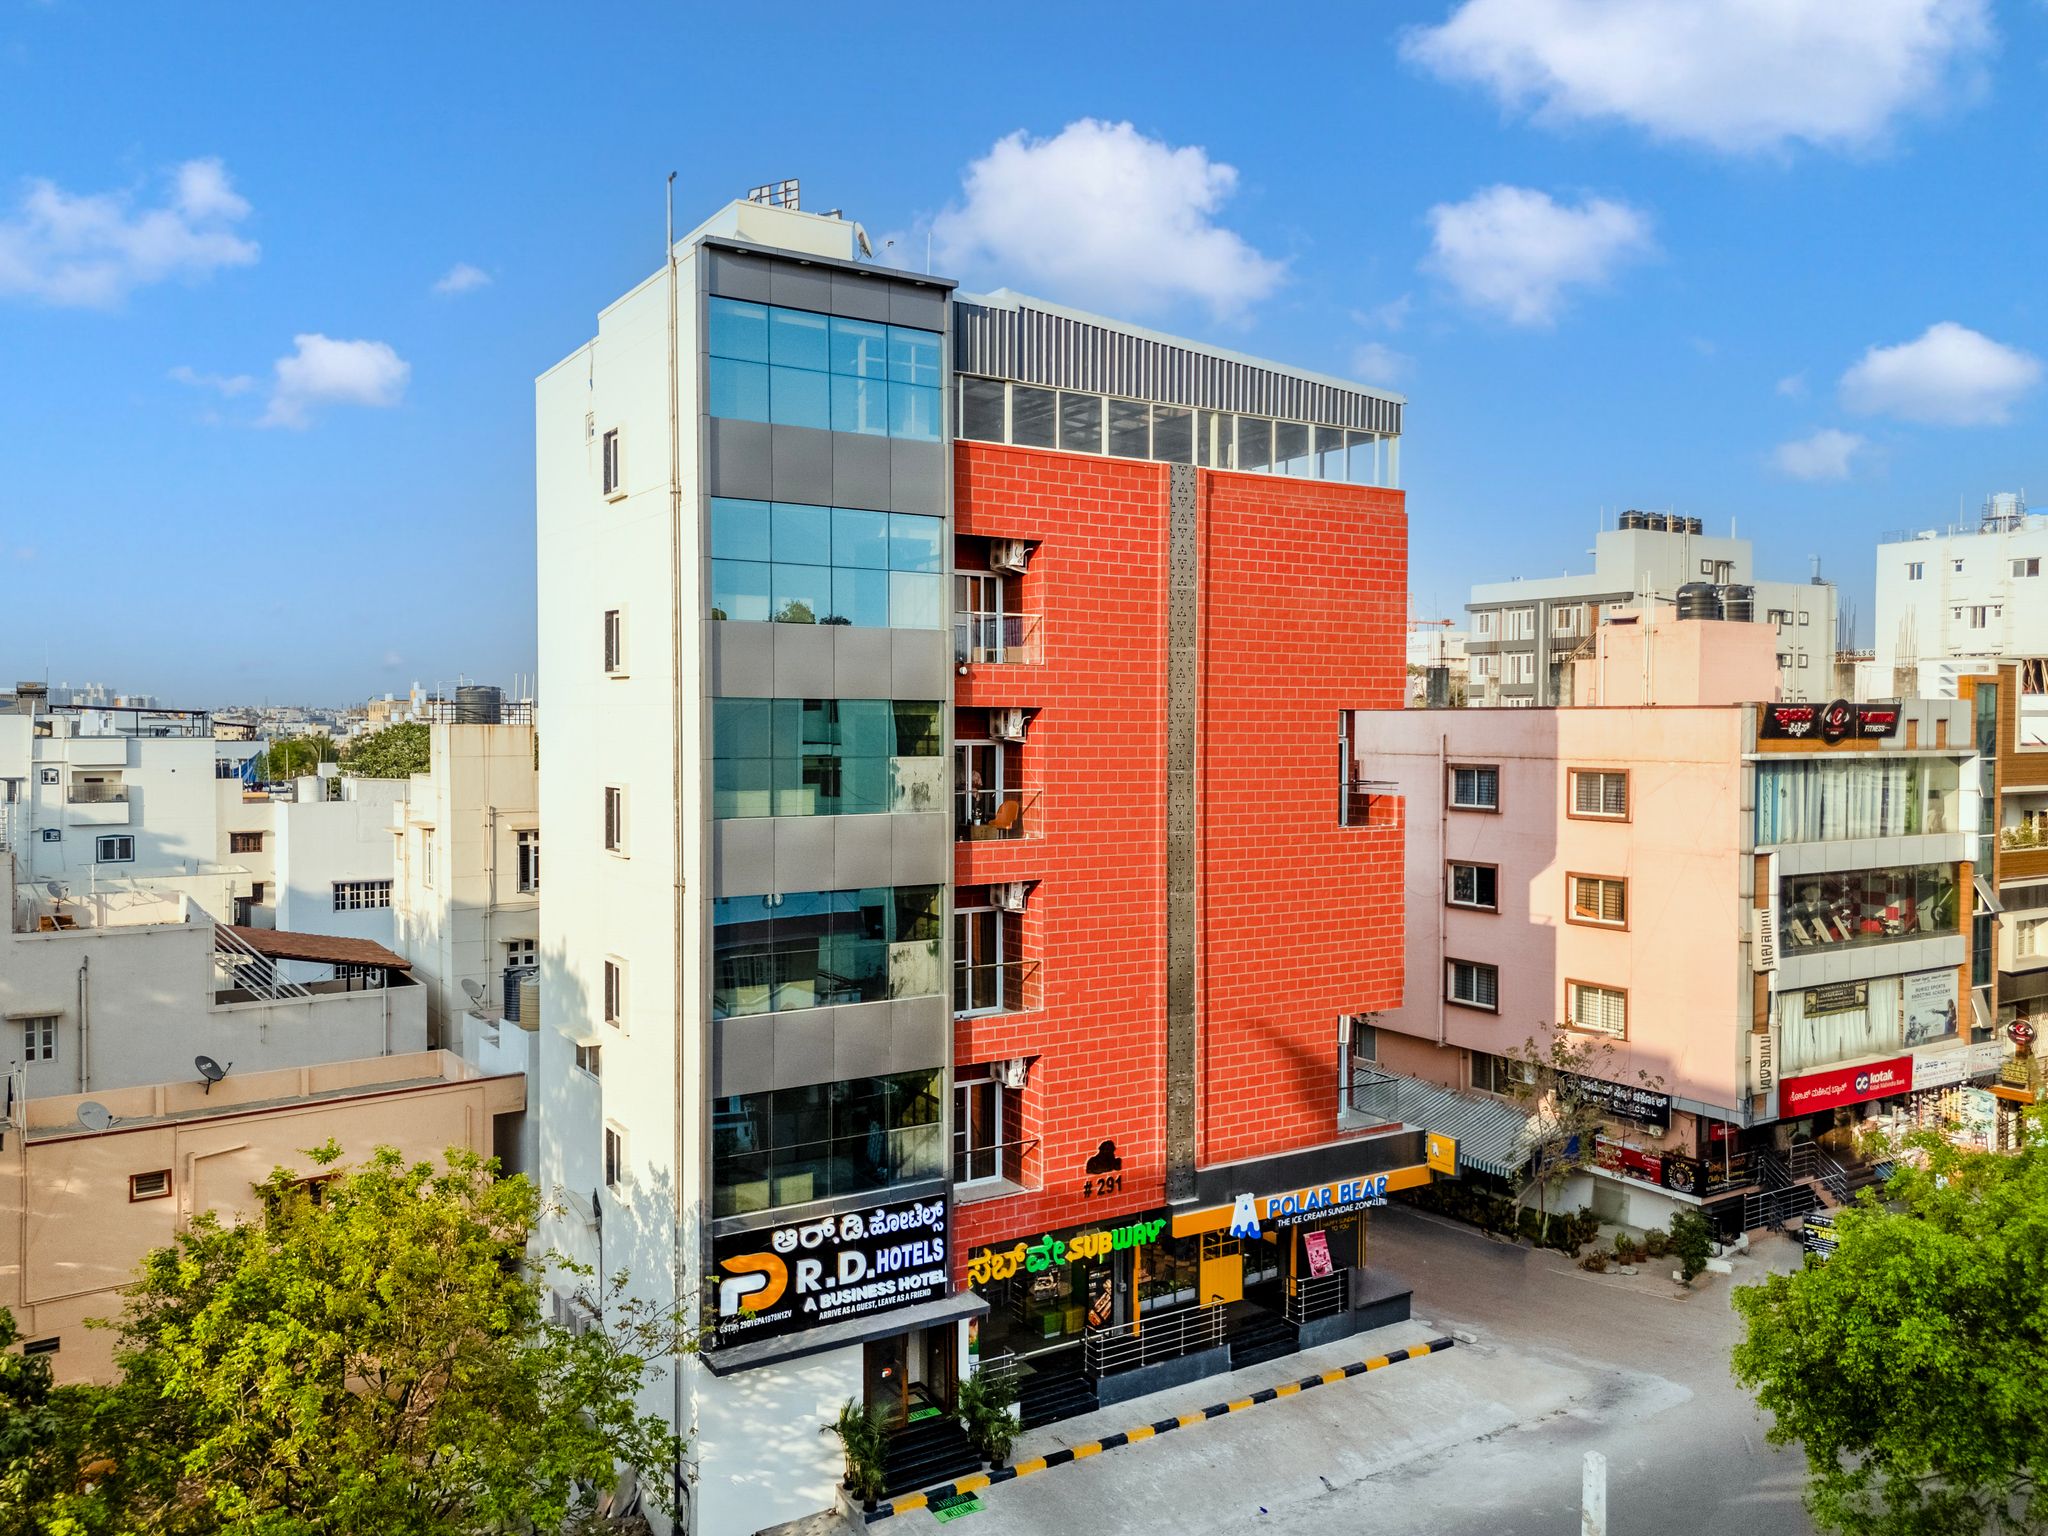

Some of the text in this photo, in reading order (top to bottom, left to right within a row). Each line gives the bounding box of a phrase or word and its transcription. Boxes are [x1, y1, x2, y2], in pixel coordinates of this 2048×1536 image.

[1864, 724, 1885, 732] FITNESS
[1870, 1069, 1893, 1084] kotak
[1083, 1175, 1122, 1198] # 291
[1267, 1175, 1388, 1219] POLAR BEAR
[1277, 1217, 1291, 1227] THE
[1292, 1215, 1302, 1225] ICE
[1303, 1209, 1327, 1222] CREAM
[1328, 1204, 1354, 1216] SUNDAE
[1065, 1217, 1167, 1262] SUBWAY
[876, 1238, 944, 1274] HOTELS
[802, 1270, 947, 1312] A BUSINESS HOTEL
[819, 1288, 931, 1320] ARRIVE AS A GUEST, LEAVE AS A FRIEND
[942, 1502, 978, 1518] WELCOME
